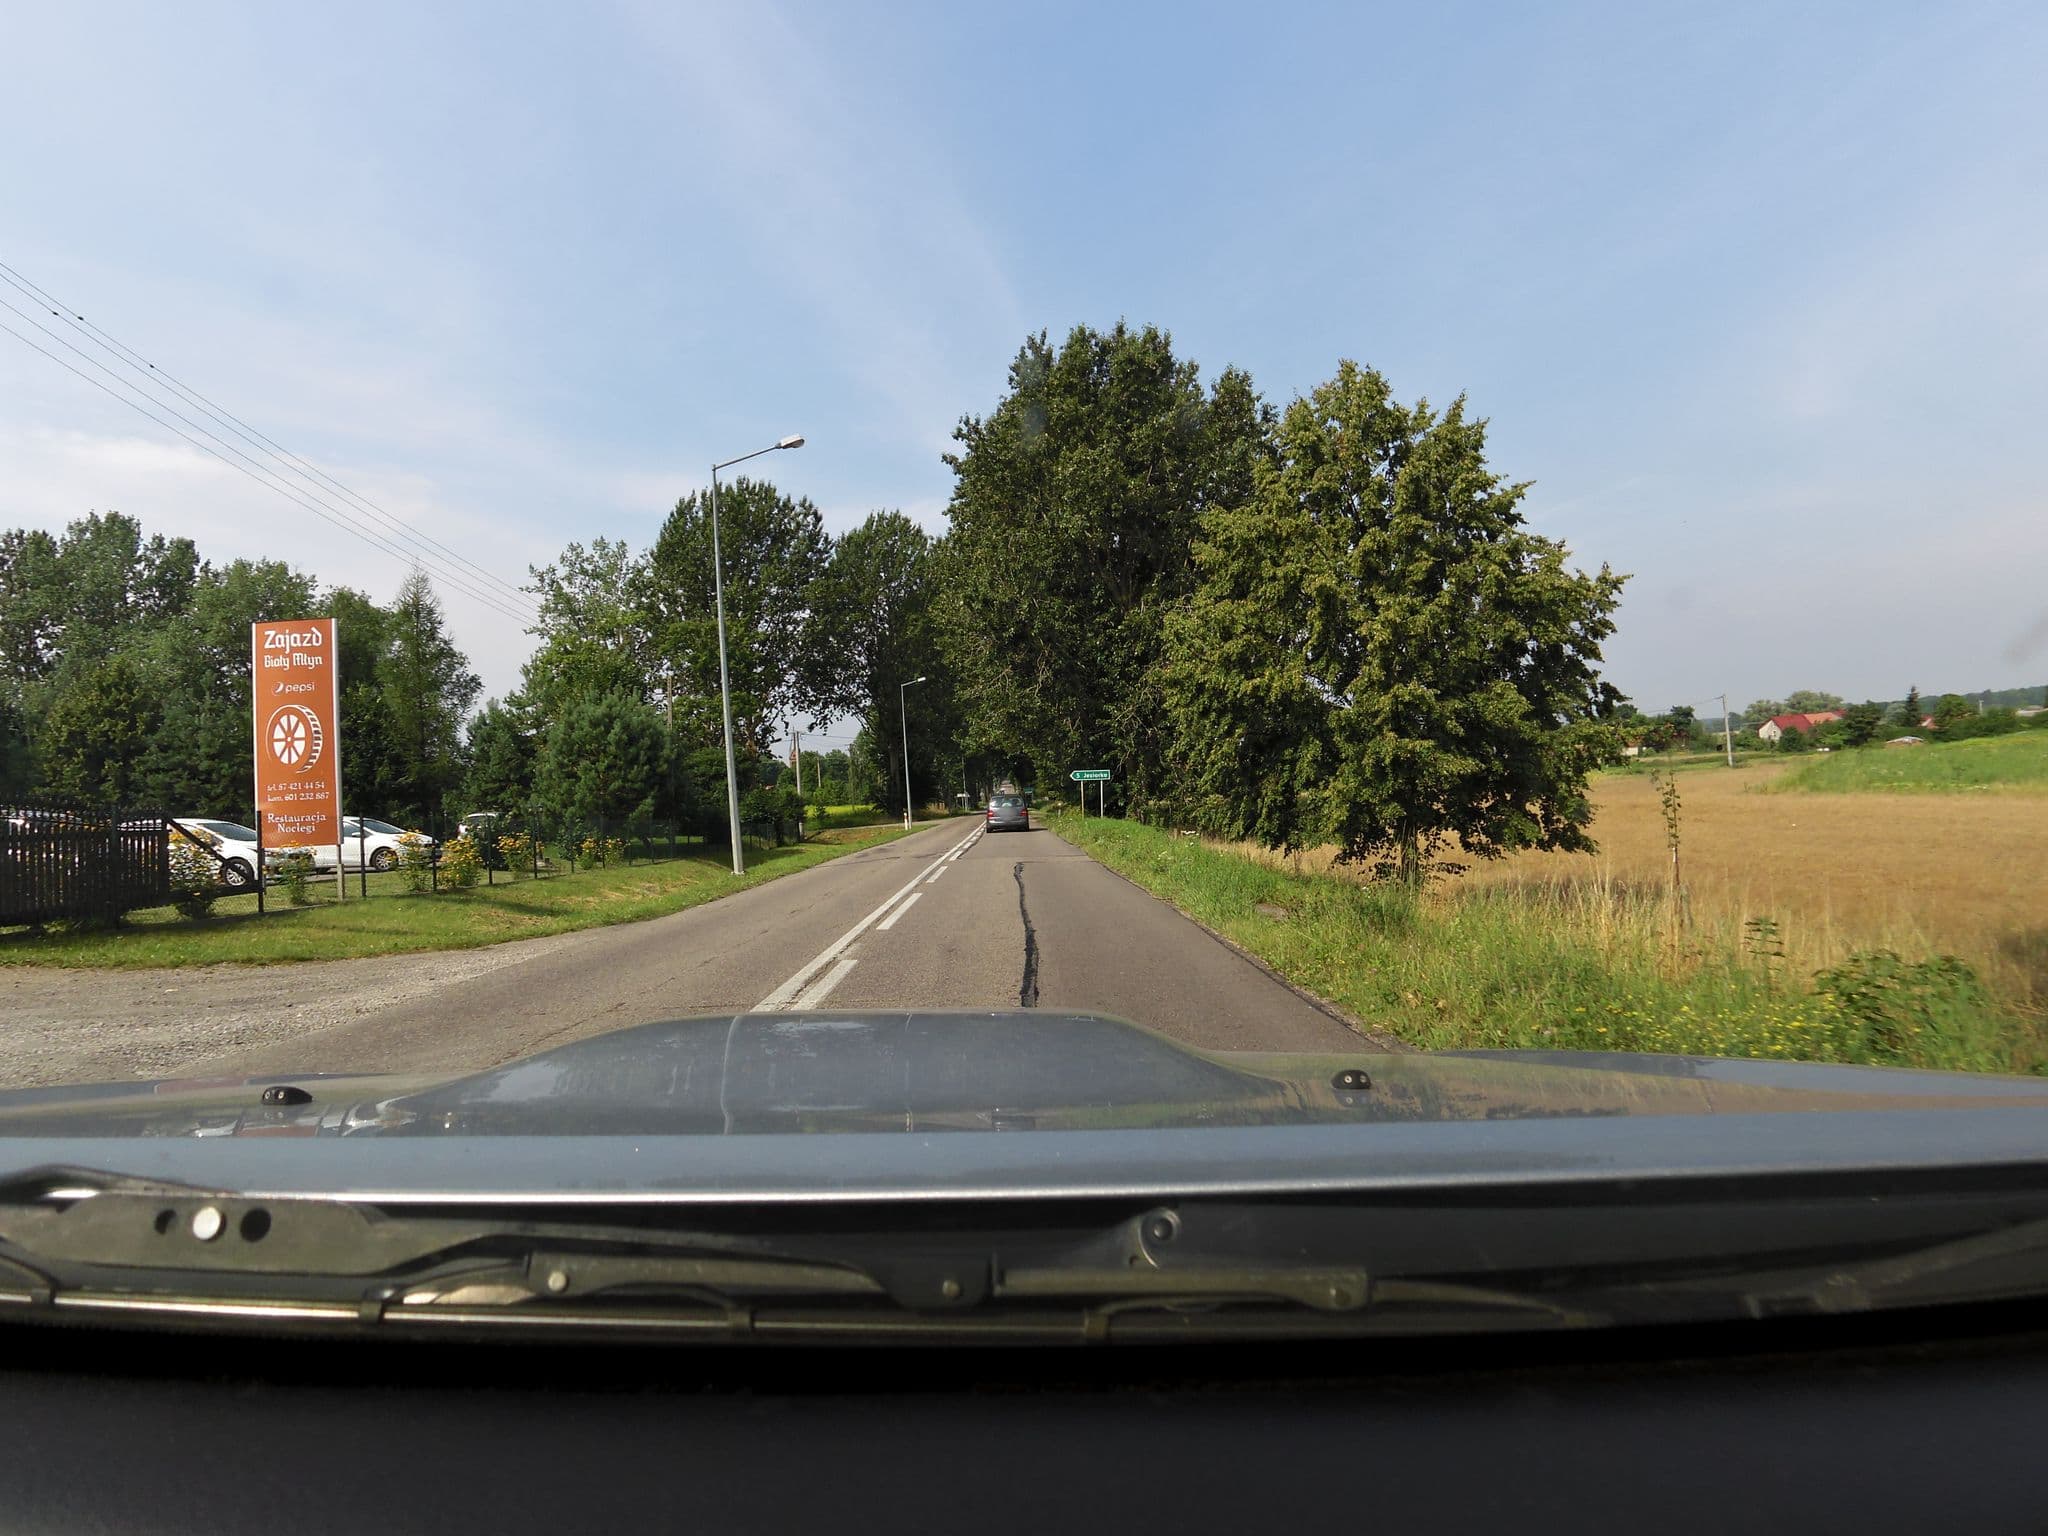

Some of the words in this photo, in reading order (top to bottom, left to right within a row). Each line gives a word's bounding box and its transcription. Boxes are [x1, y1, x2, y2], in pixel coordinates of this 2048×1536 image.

[264, 626, 322, 654] Zajazd
[285, 682, 315, 694] pepsi
[285, 793, 297, 801] 601
[267, 812, 327, 823] Restauracja
[278, 823, 315, 834] Noclegi
